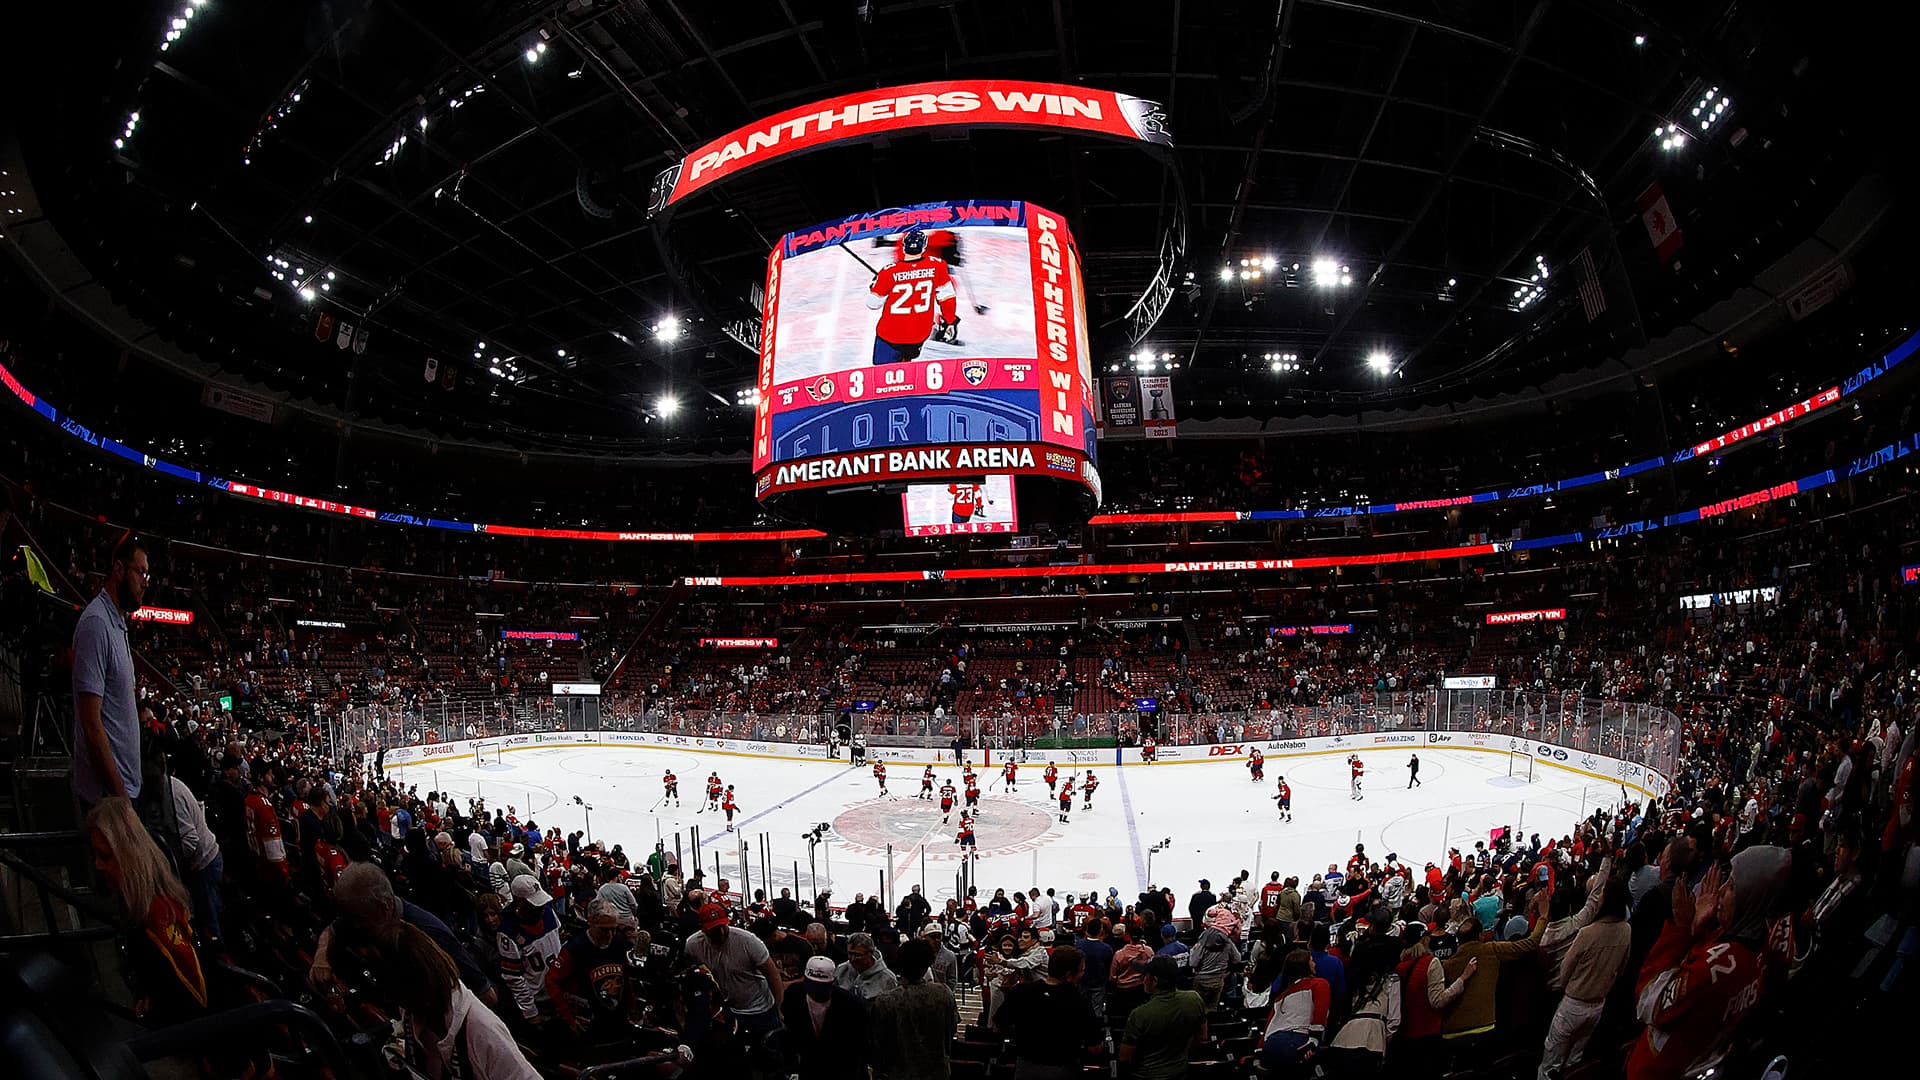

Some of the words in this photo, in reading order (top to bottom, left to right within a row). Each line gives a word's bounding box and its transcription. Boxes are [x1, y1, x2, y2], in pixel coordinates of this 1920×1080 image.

[690, 92, 981, 180] PANTHERS
[988, 91, 1102, 120] WIN
[789, 207, 952, 250] PANTHERS
[956, 205, 1019, 221] WIN
[892, 268, 936, 282] VERHAEGHE
[1037, 213, 1068, 362] PANTHERS
[890, 280, 933, 314] 23
[761, 249, 781, 391] PANTHERS
[849, 371, 865, 398] 3
[926, 362, 943, 390] 6
[1048, 369, 1074, 437] WIN
[758, 396, 770, 459] WIN
[776, 453, 886, 485] AMERANT
[889, 448, 952, 473] BANK
[956, 447, 1036, 469] ARENA
[956, 488, 974, 505] 23
[1395, 498, 1452, 511] PANTHERS
[1452, 495, 1473, 505] WIN
[1699, 490, 1770, 519] PANTHERS
[1770, 481, 1798, 500] WIN
[619, 533, 673, 541] PANTHERS
[674, 533, 694, 541] WIN
[1165, 560, 1257, 572] PANTHERS
[1262, 560, 1293, 569] WIN
[694, 577, 722, 586] WIN
[174, 612, 190, 622] WIN
[423, 744, 455, 757] SEATGEEK
[1208, 744, 1246, 756] DEX
[1267, 741, 1306, 750] AutoNation
[1386, 735, 1416, 743] AMAZING
[1706, 943, 1737, 984] 42
